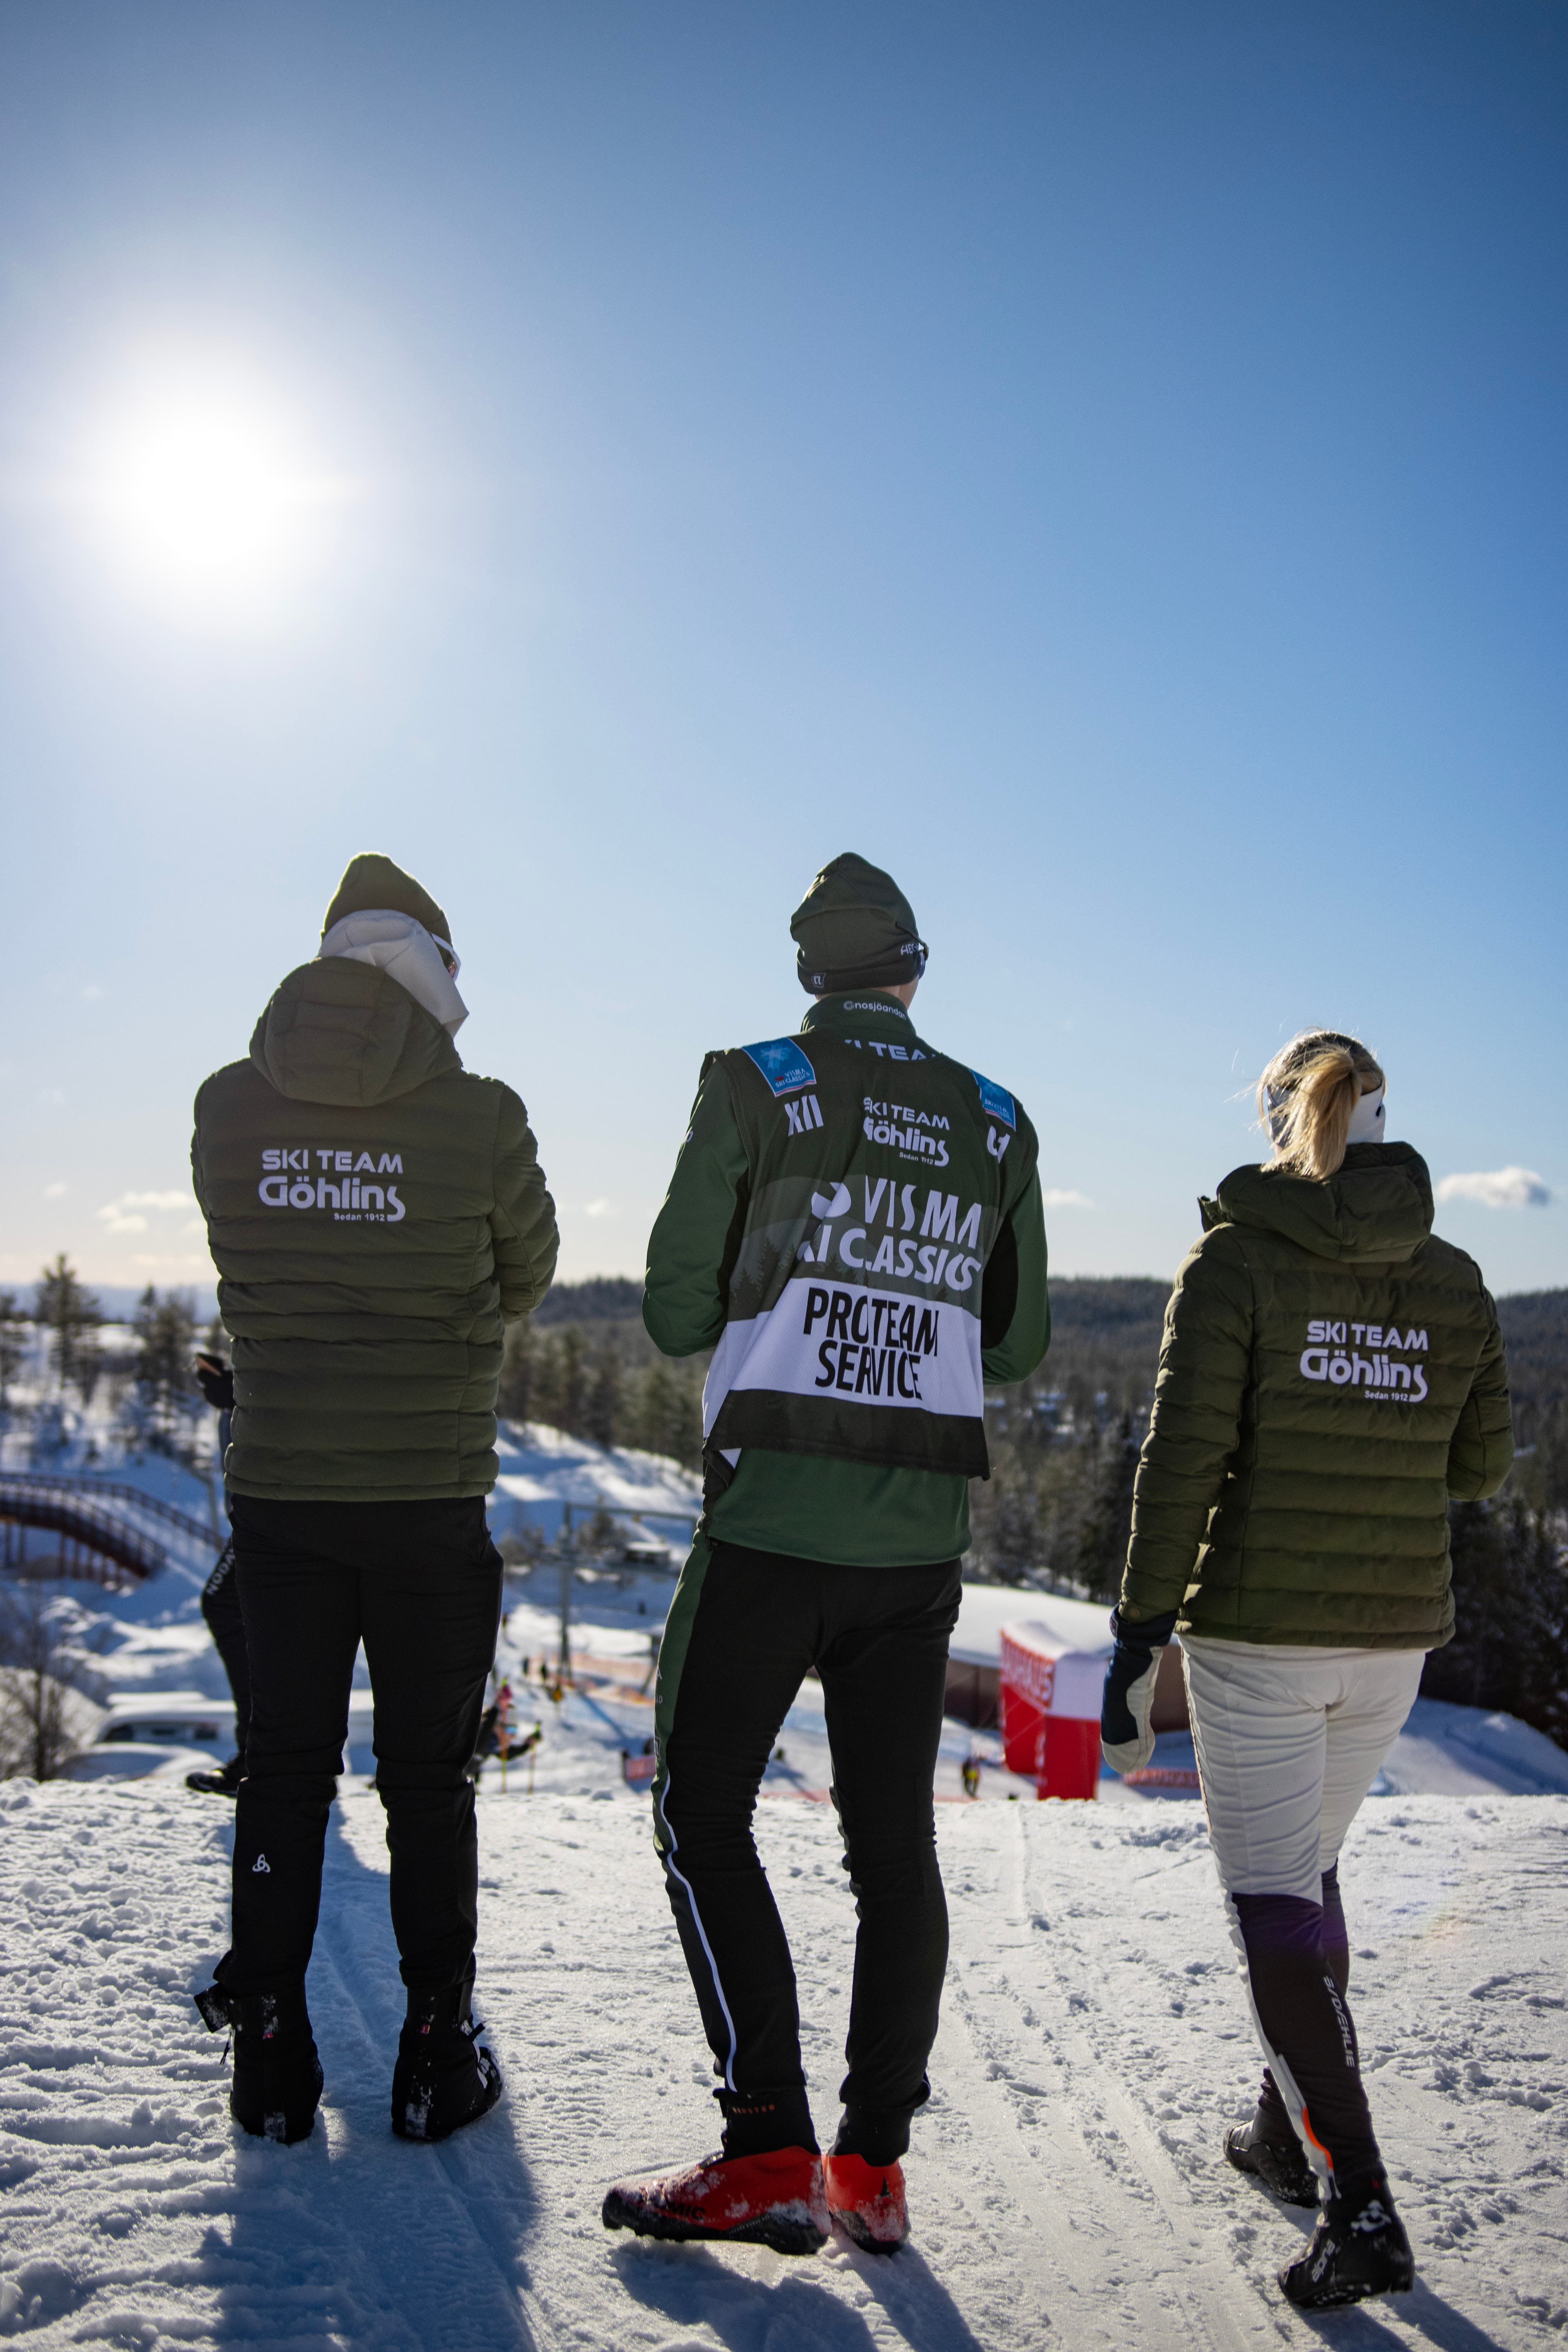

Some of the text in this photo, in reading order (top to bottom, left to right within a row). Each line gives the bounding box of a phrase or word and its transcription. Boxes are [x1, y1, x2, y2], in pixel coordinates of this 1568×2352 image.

[869, 1041, 936, 1061] TEA
[891, 1104, 950, 1131] TEAM
[262, 1149, 403, 1174] SKI TEAM
[899, 1151, 918, 1162] Sedan
[258, 1176, 405, 1222] Göhlins
[865, 1175, 982, 1250] VISMA
[334, 1212, 385, 1221] Sedan 1912
[1307, 1320, 1428, 1351] SKI TEAM
[815, 1339, 923, 1401] SERVICE
[1300, 1348, 1428, 1403] Göhlins
[1365, 1390, 1409, 1402] Sedan 1912
